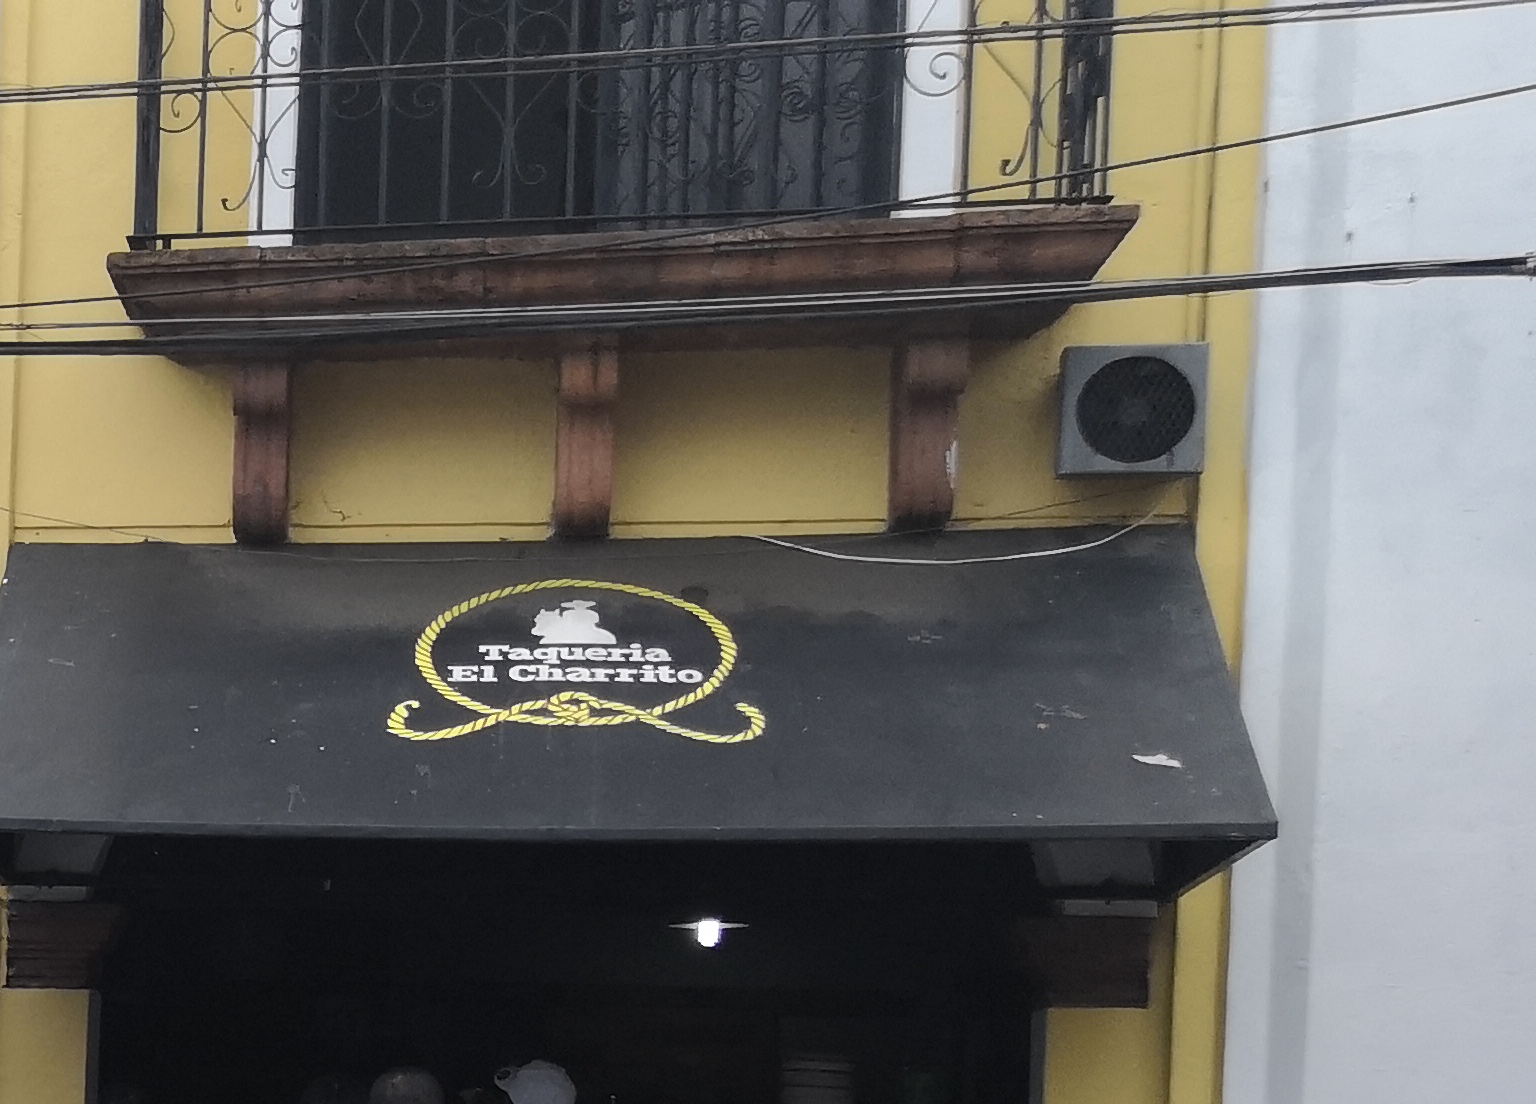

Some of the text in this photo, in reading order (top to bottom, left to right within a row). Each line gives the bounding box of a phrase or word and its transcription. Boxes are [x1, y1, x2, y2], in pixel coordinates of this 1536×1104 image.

[478, 643, 672, 664] Taqueria
[447, 664, 703, 683] El Charrito
